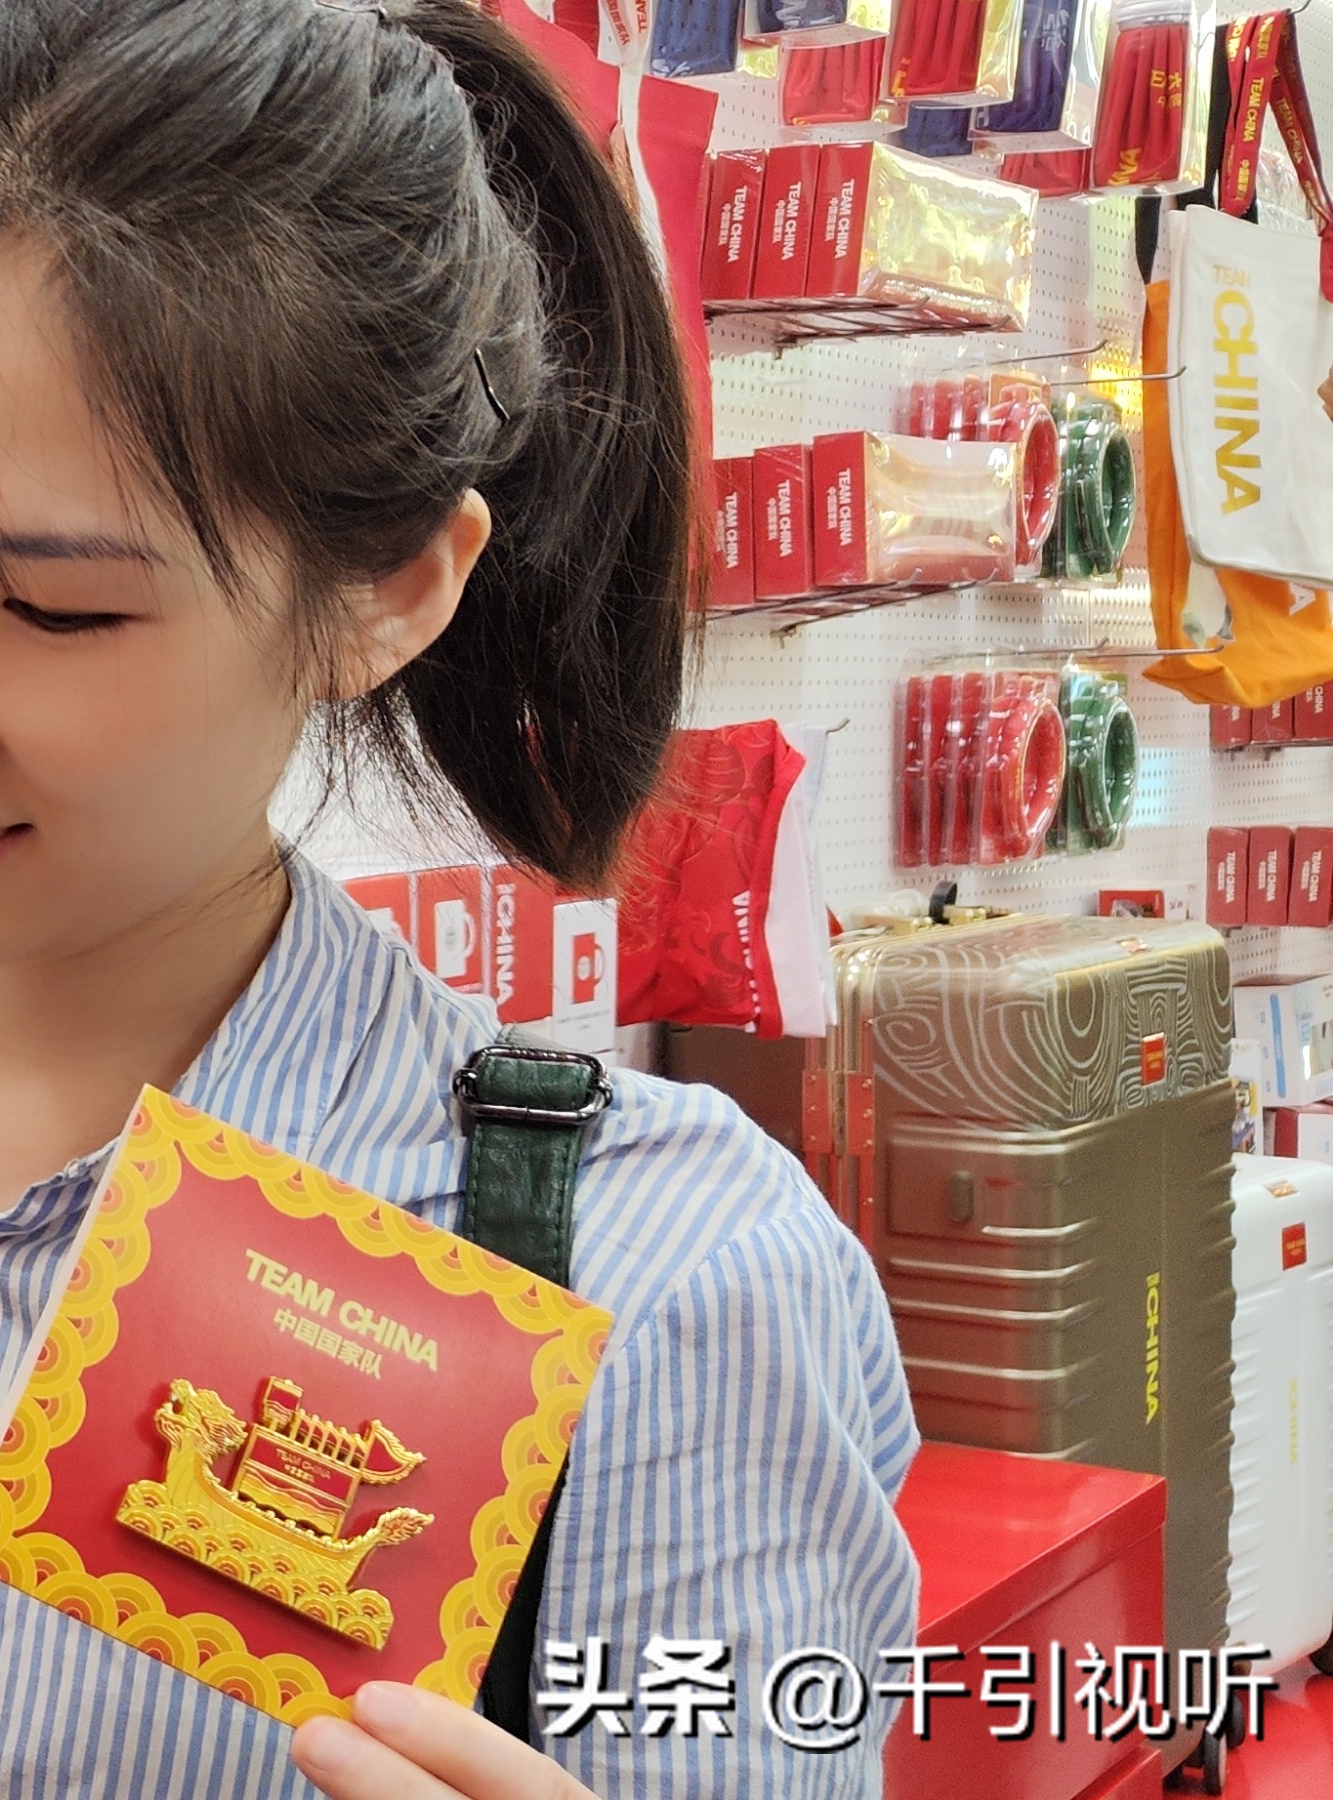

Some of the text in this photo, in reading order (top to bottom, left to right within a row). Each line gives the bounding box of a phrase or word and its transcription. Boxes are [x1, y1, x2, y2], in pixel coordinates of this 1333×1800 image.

[606, 0, 631, 45] 国国家队
[1243, 78, 1264, 142] TEAM CHINA
[727, 185, 747, 263] TEAM CHINA
[782, 181, 801, 260] TEAM CHINA
[835, 178, 855, 259] TEAM CHINA
[1213, 265, 1252, 289] TEAM
[1212, 289, 1261, 516] CHINA
[725, 491, 739, 569] TEAM CHINA
[777, 479, 792, 557] TEAM CHINA
[838, 467, 852, 547] TEAM CHINA
[496, 894, 516, 1005] CHINA
[245, 1248, 438, 1372] TEAM CHINA
[272, 1308, 382, 1380] 中国国家队
[1146, 1287, 1160, 1425] CHINA
[275, 1448, 332, 1480] TEAM CHINA
